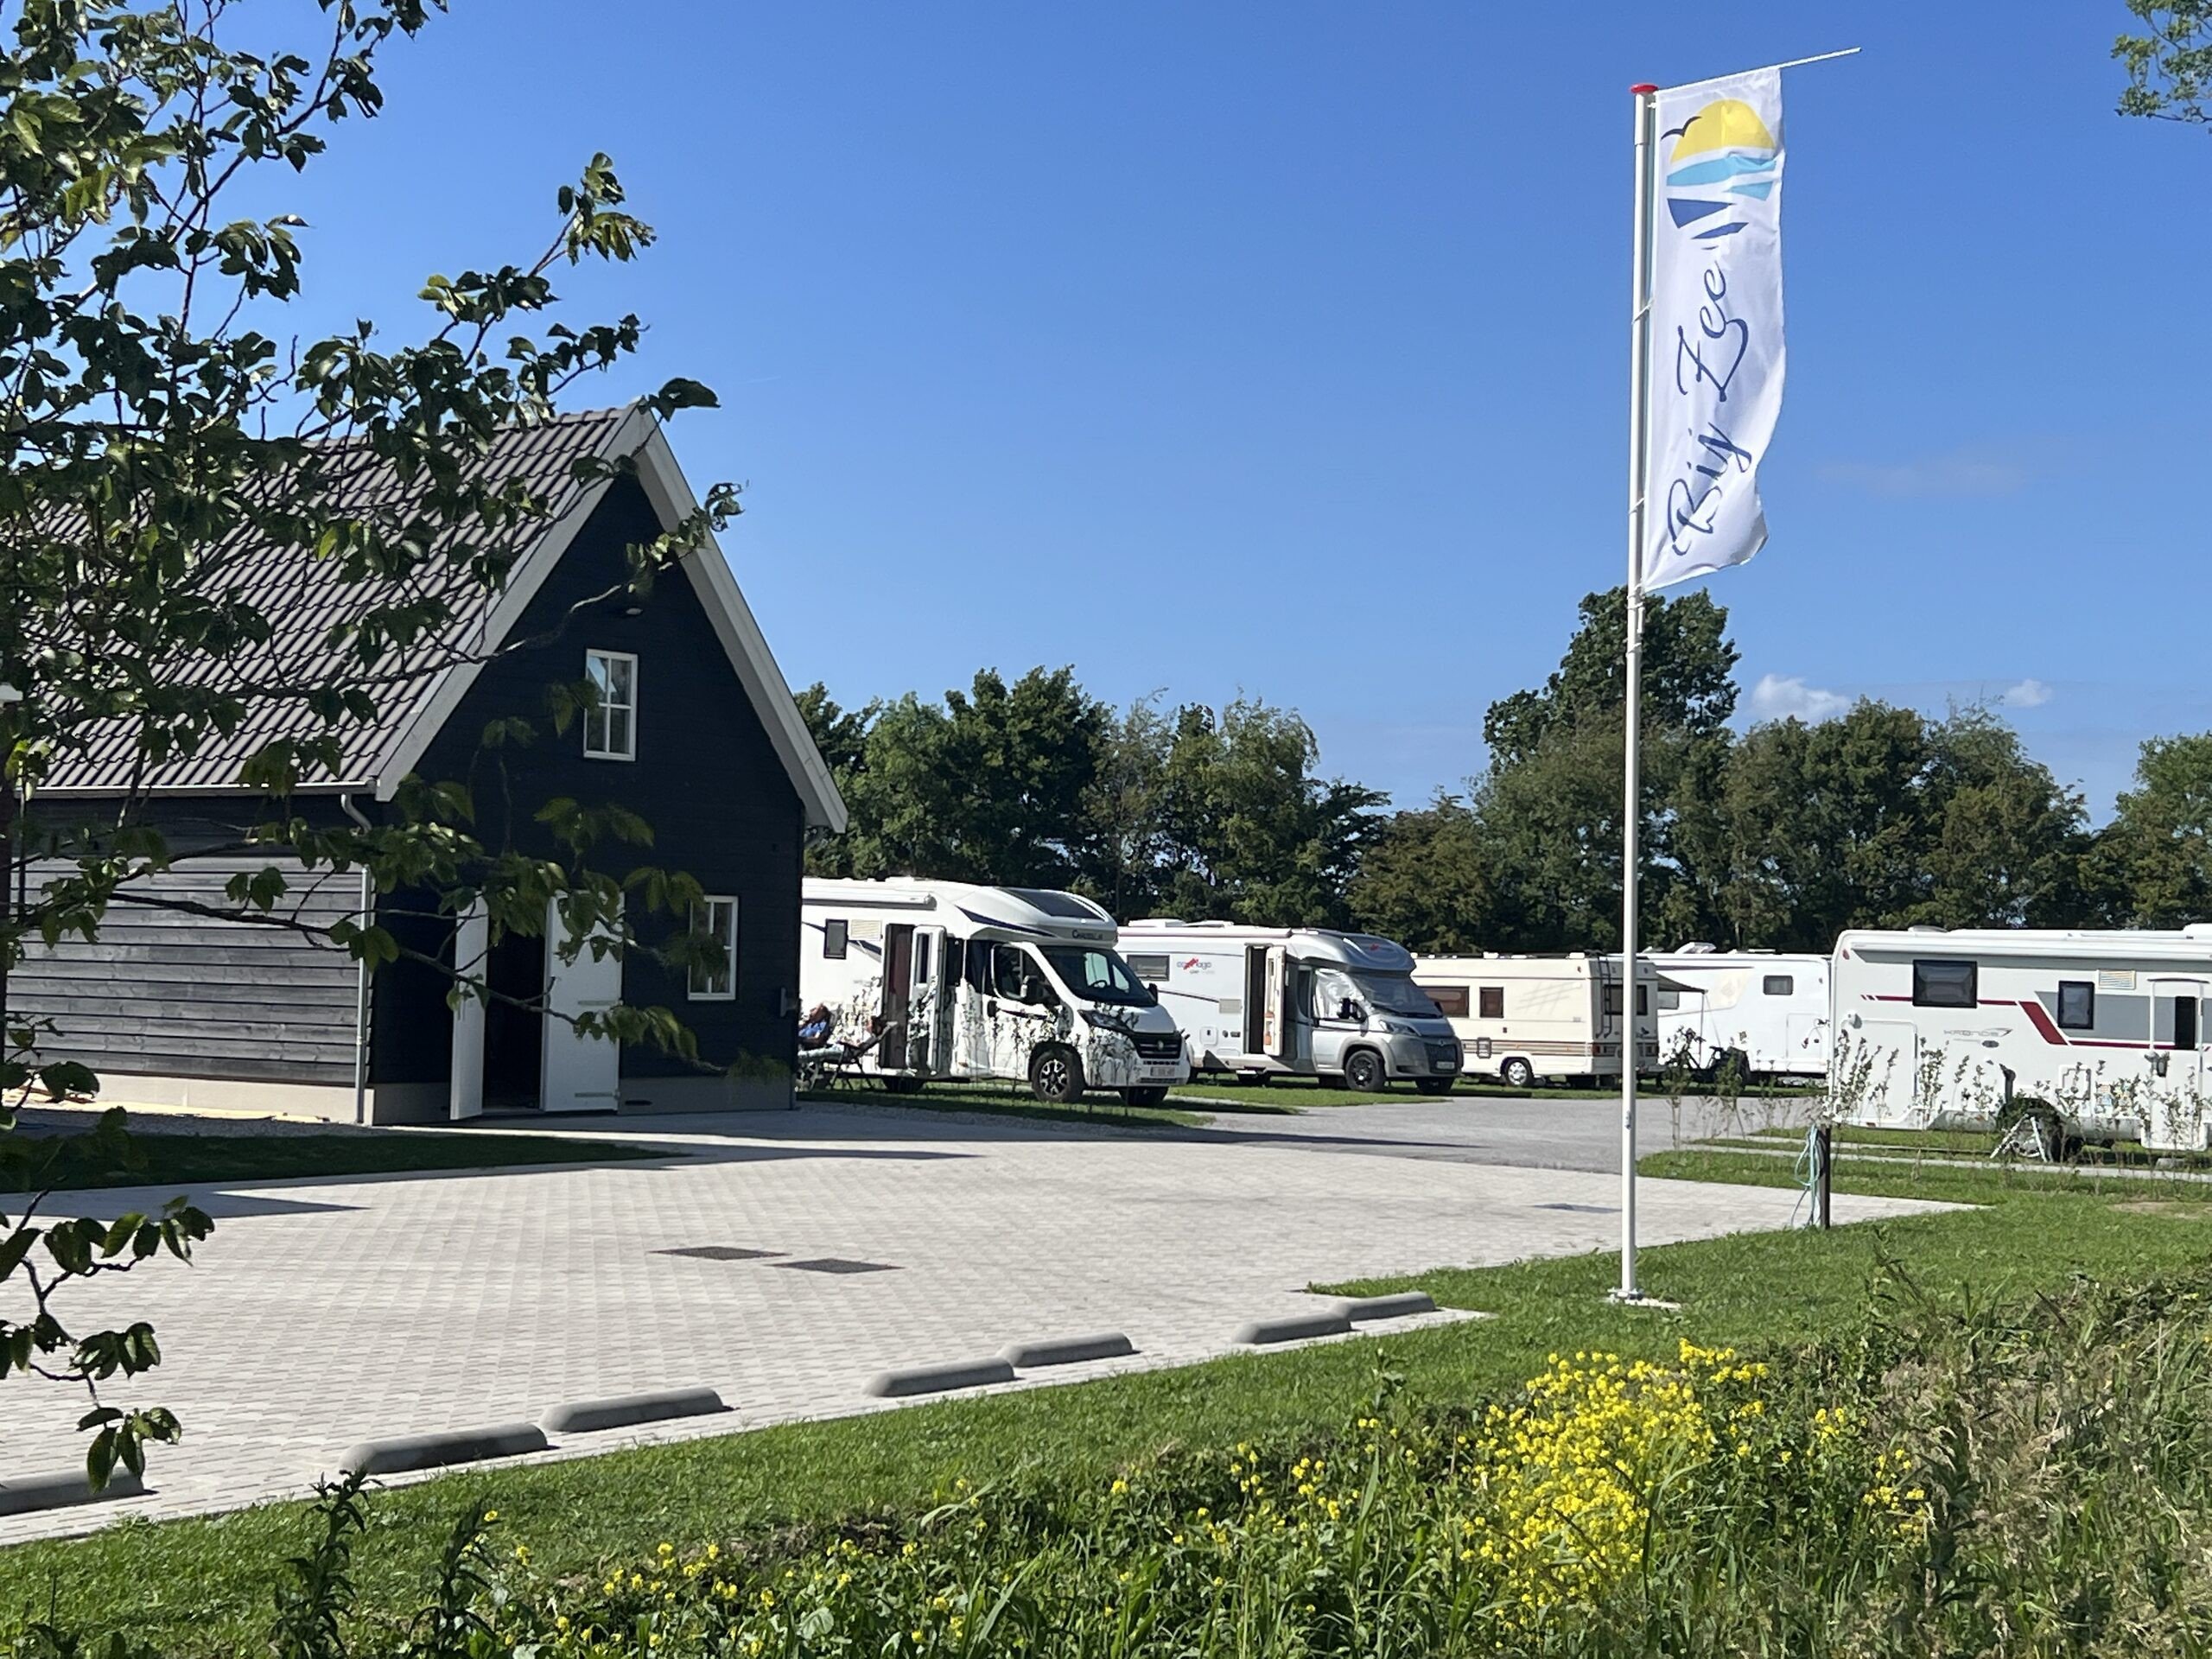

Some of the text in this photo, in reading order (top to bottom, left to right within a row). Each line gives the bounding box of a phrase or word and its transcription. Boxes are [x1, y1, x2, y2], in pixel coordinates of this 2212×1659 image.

[1667, 259, 1752, 556] Bij Zee
[1176, 958, 1212, 970] caago
